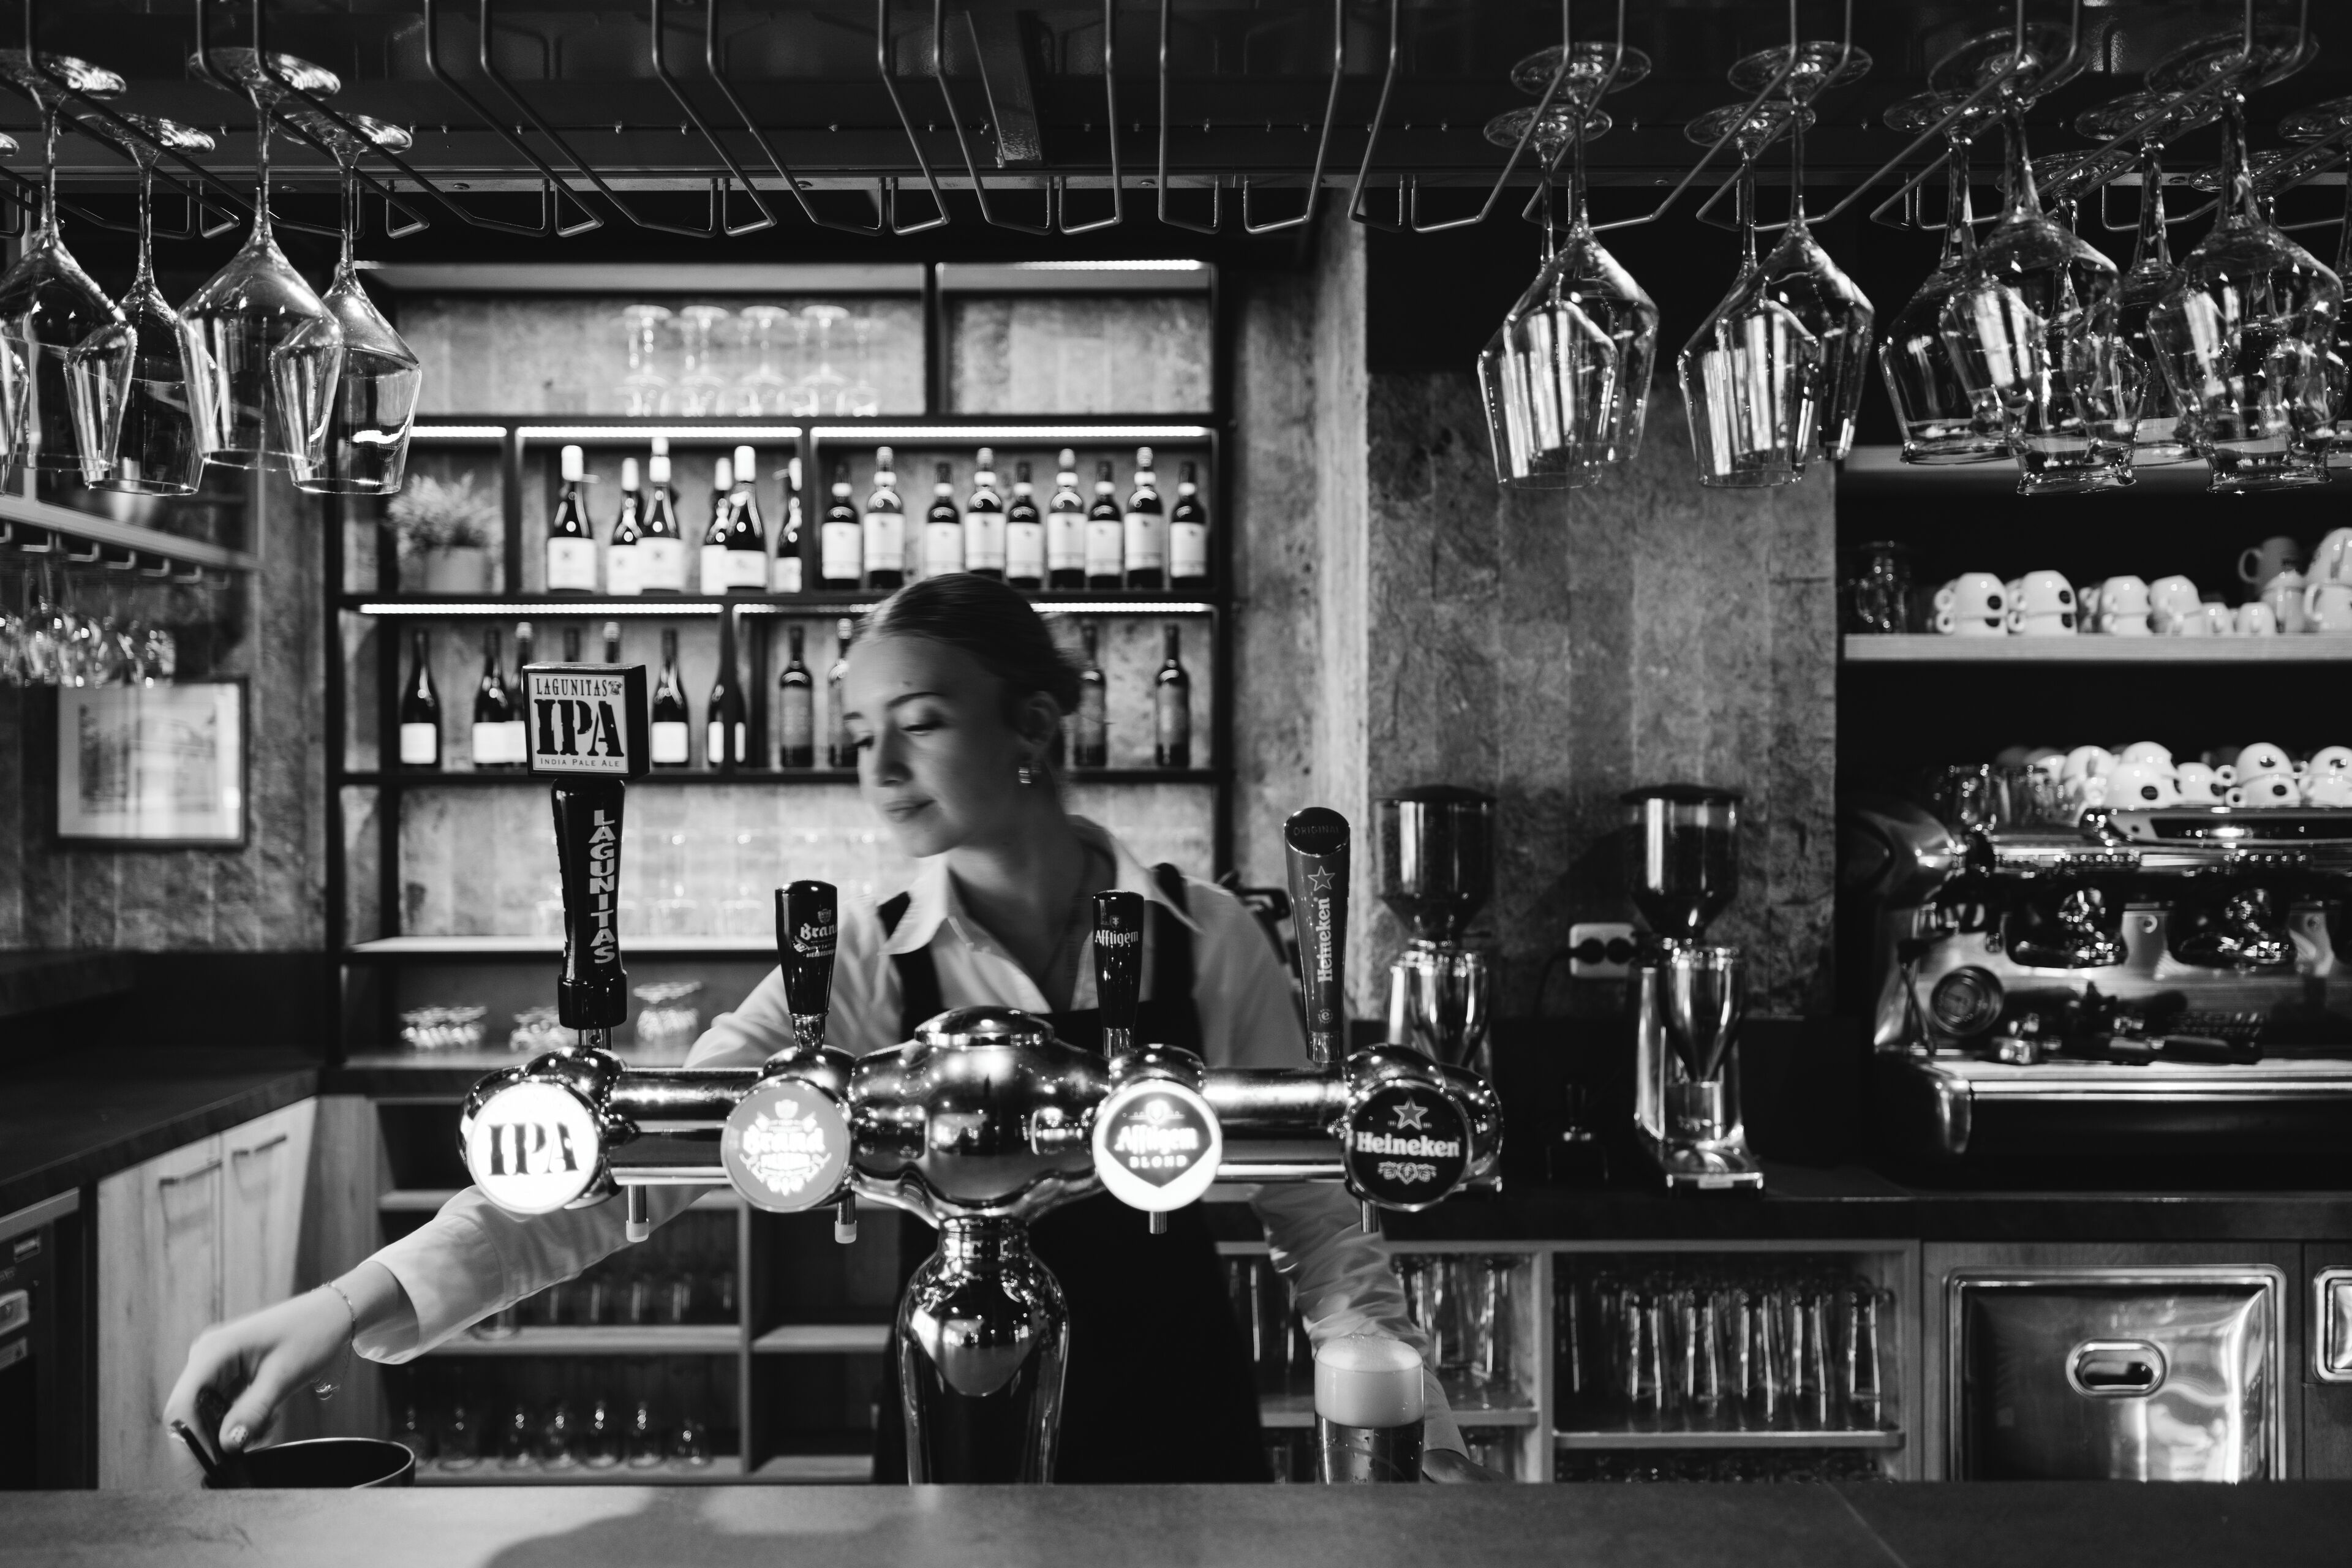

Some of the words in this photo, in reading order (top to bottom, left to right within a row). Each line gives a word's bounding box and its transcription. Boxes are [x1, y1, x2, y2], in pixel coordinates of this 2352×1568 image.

[535, 678, 607, 696] LAGUNITAS
[534, 698, 624, 757] IPA
[588, 809, 616, 963] LAGUNITAS
[1095, 930, 1139, 947] Affligem
[1316, 897, 1333, 982] Heineken
[488, 1121, 579, 1176] IPA
[1356, 1131, 1460, 1157] Heineken
